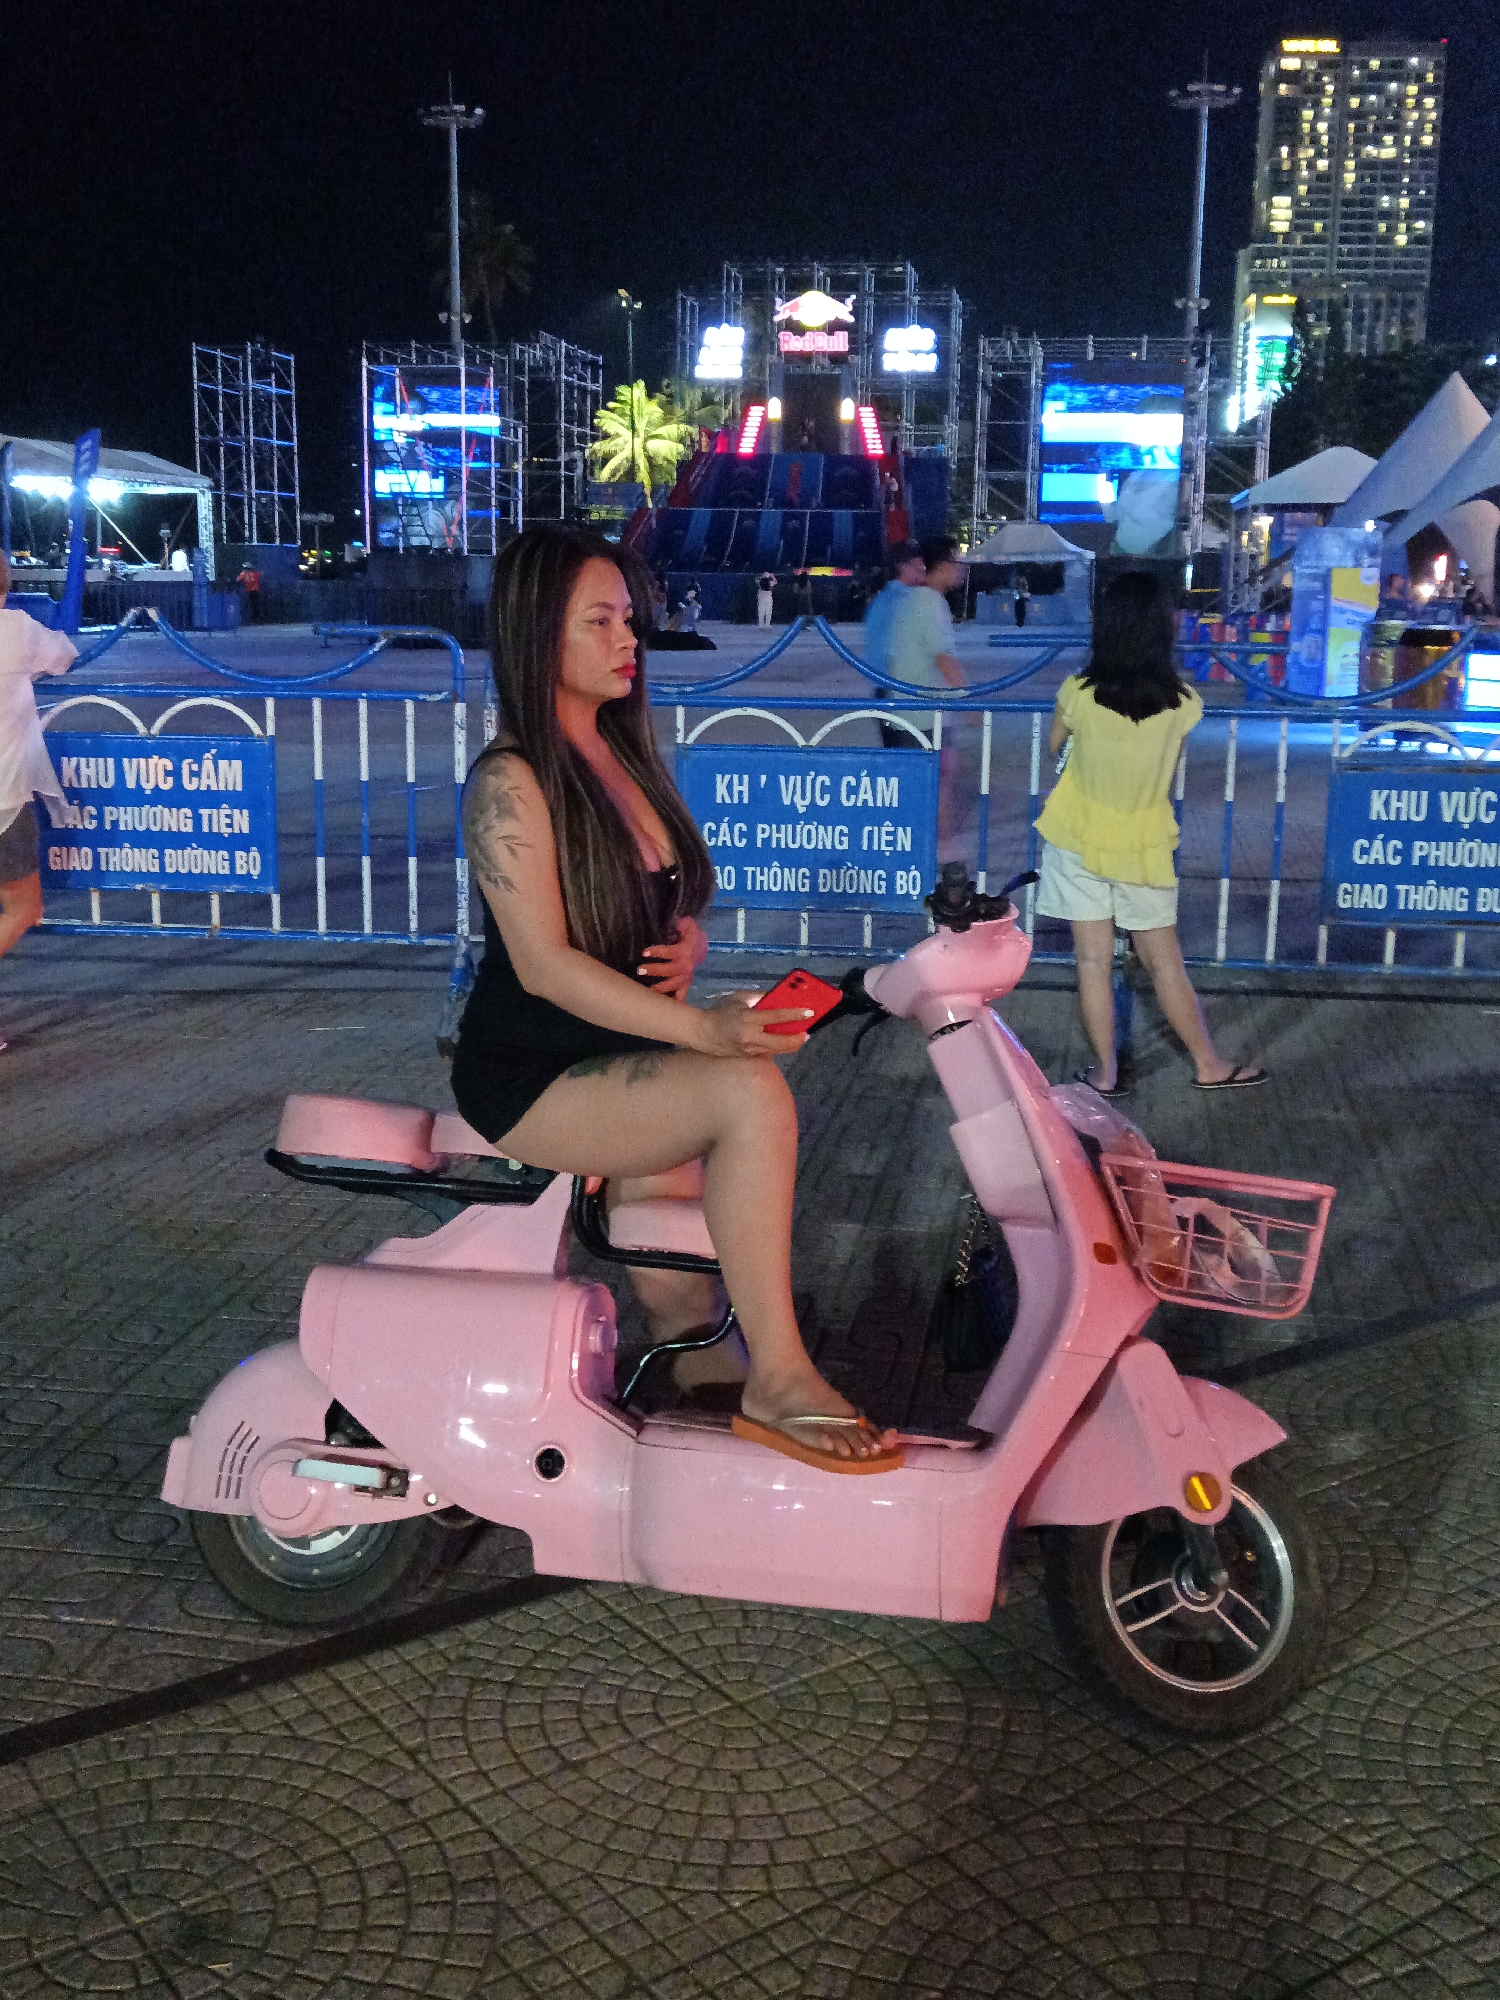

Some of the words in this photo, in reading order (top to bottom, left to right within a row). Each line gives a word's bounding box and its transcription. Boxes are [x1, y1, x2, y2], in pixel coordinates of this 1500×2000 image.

[778, 331, 814, 351] Red
[815, 331, 849, 351] Bull
[61, 757, 115, 789] KHU
[122, 755, 174, 794] VỰC
[181, 748, 243, 791] CẤM
[779, 770, 831, 813] VỰC
[1369, 789, 1429, 822] KHU
[1439, 786, 1499, 830] VỰC
[104, 804, 193, 833] PHƯƠNG
[198, 803, 250, 837] TIỆN
[702, 816, 748, 848] CÁC
[756, 820, 849, 850] PHƯƠNG
[48, 846, 93, 871] GIAO
[97, 842, 160, 873] THÔNG
[164, 843, 230, 875] ĐƯỜNG
[234, 846, 262, 880] BỘ
[1352, 833, 1404, 866] CÁC
[743, 860, 810, 893] THÔNG
[818, 861, 887, 895] ĐƯỜNG
[1336, 882, 1388, 910] GIAO
[1395, 879, 1470, 912] THÔNG
